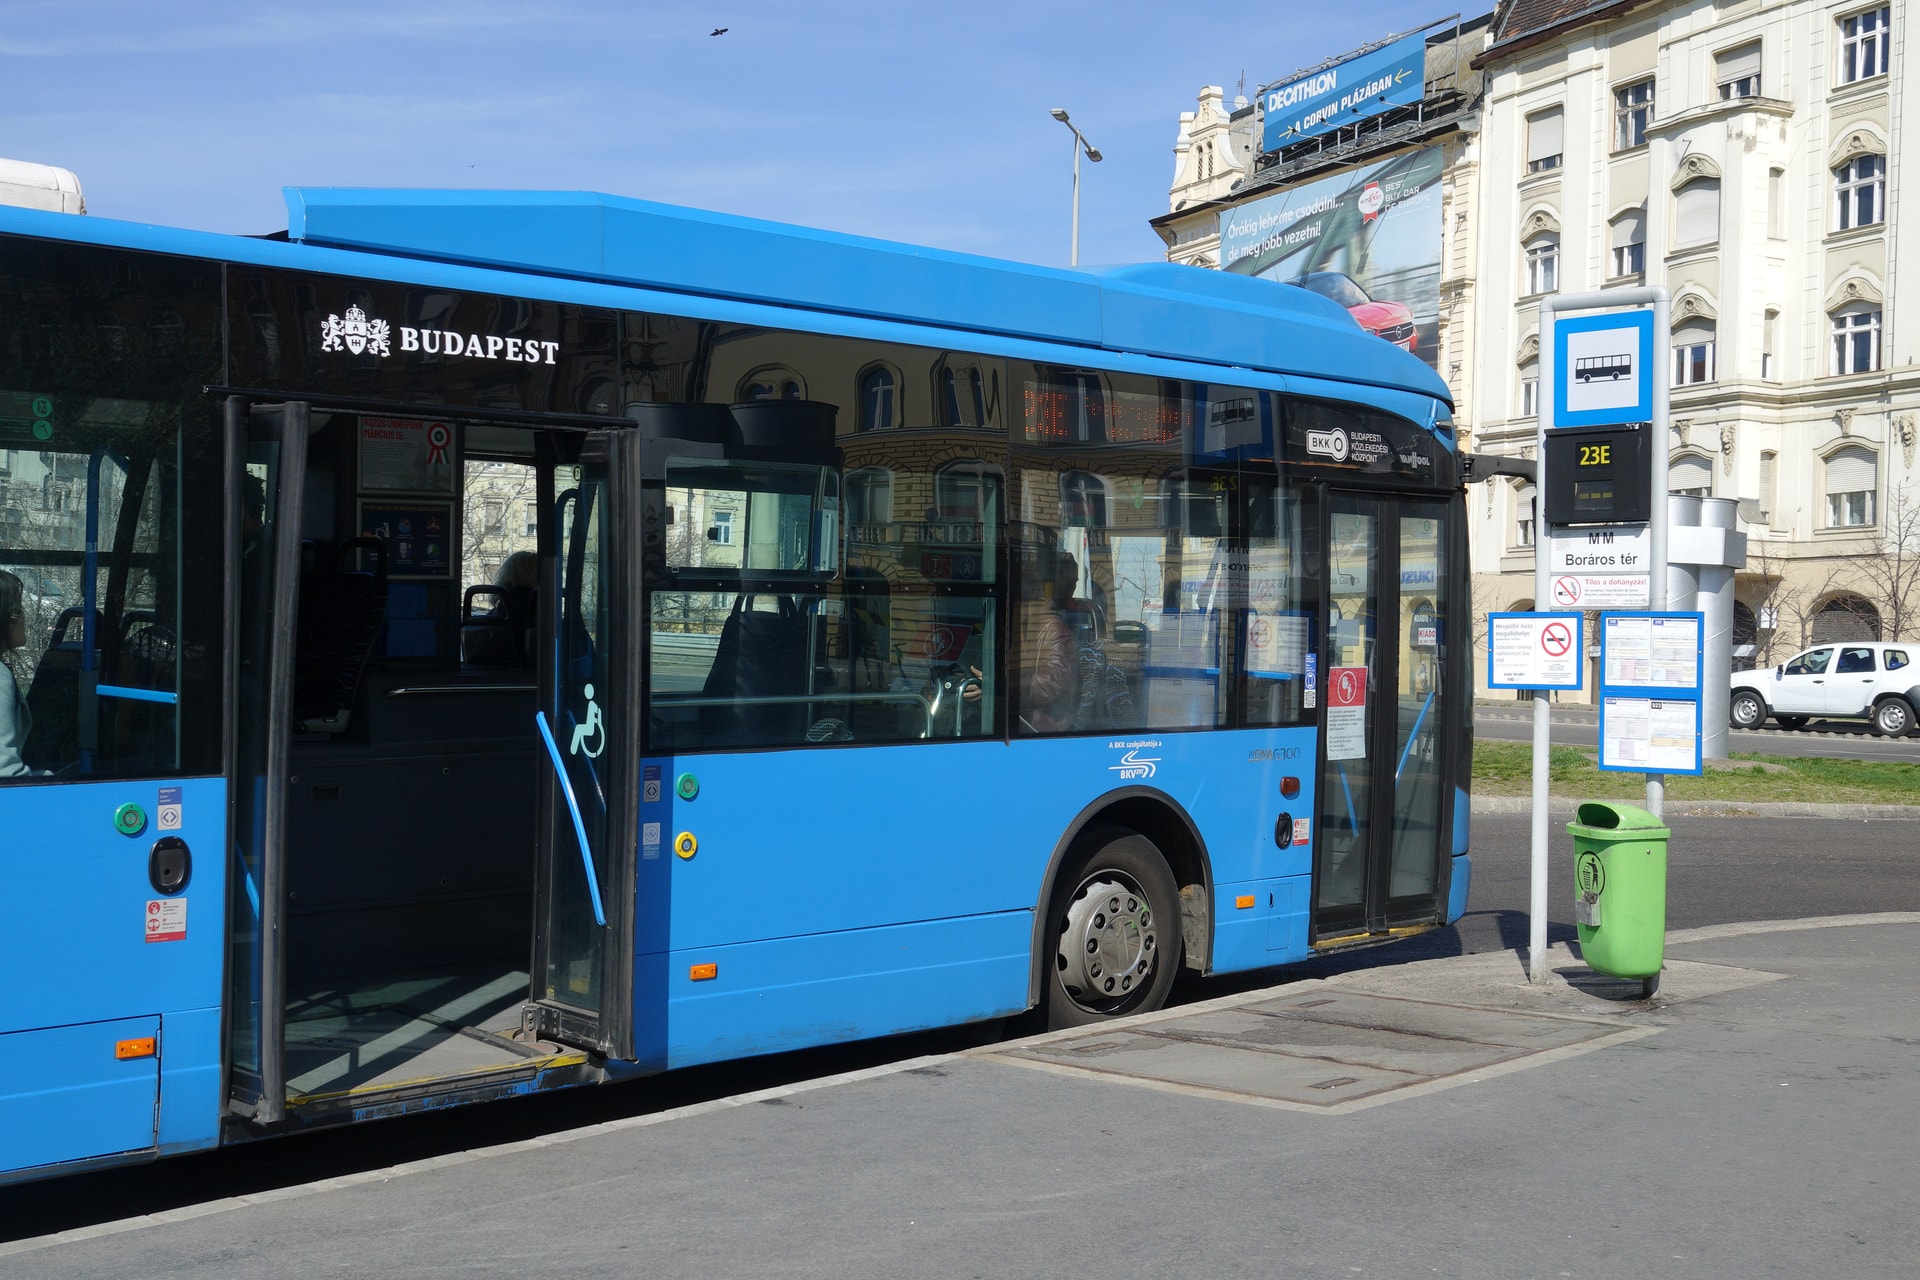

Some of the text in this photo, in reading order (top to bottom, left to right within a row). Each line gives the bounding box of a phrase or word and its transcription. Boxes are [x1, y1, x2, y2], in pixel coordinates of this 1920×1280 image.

[1268, 70, 1337, 112] DECATHLON
[1294, 74, 1392, 132] A CORVIN PLÁZÁBAN
[1386, 179, 1406, 192] BEST
[1386, 191, 1401, 202] BUY
[1403, 185, 1420, 197] CAR
[1398, 194, 1431, 208] EUROPE
[1228, 220, 1257, 239] Órákig
[1228, 220, 1322, 261] de még jobb vezetni!
[400, 326, 559, 365] BUDAPEST
[1312, 437, 1330, 449] BKK
[1351, 432, 1382, 443] BUDAPESTI
[1351, 443, 1389, 454] KÖZLEKEDÉSI
[1579, 445, 1611, 466] 23E
[1351, 452, 1378, 463] KÖZPONT
[1565, 552, 1638, 566] Boráros tér
[1585, 578, 1601, 586] Tilos
[1608, 578, 1647, 588] dohányzás!
[1108, 741, 1114, 749] A
[1114, 741, 1125, 749] BKK
[1120, 769, 1136, 779] BKV
